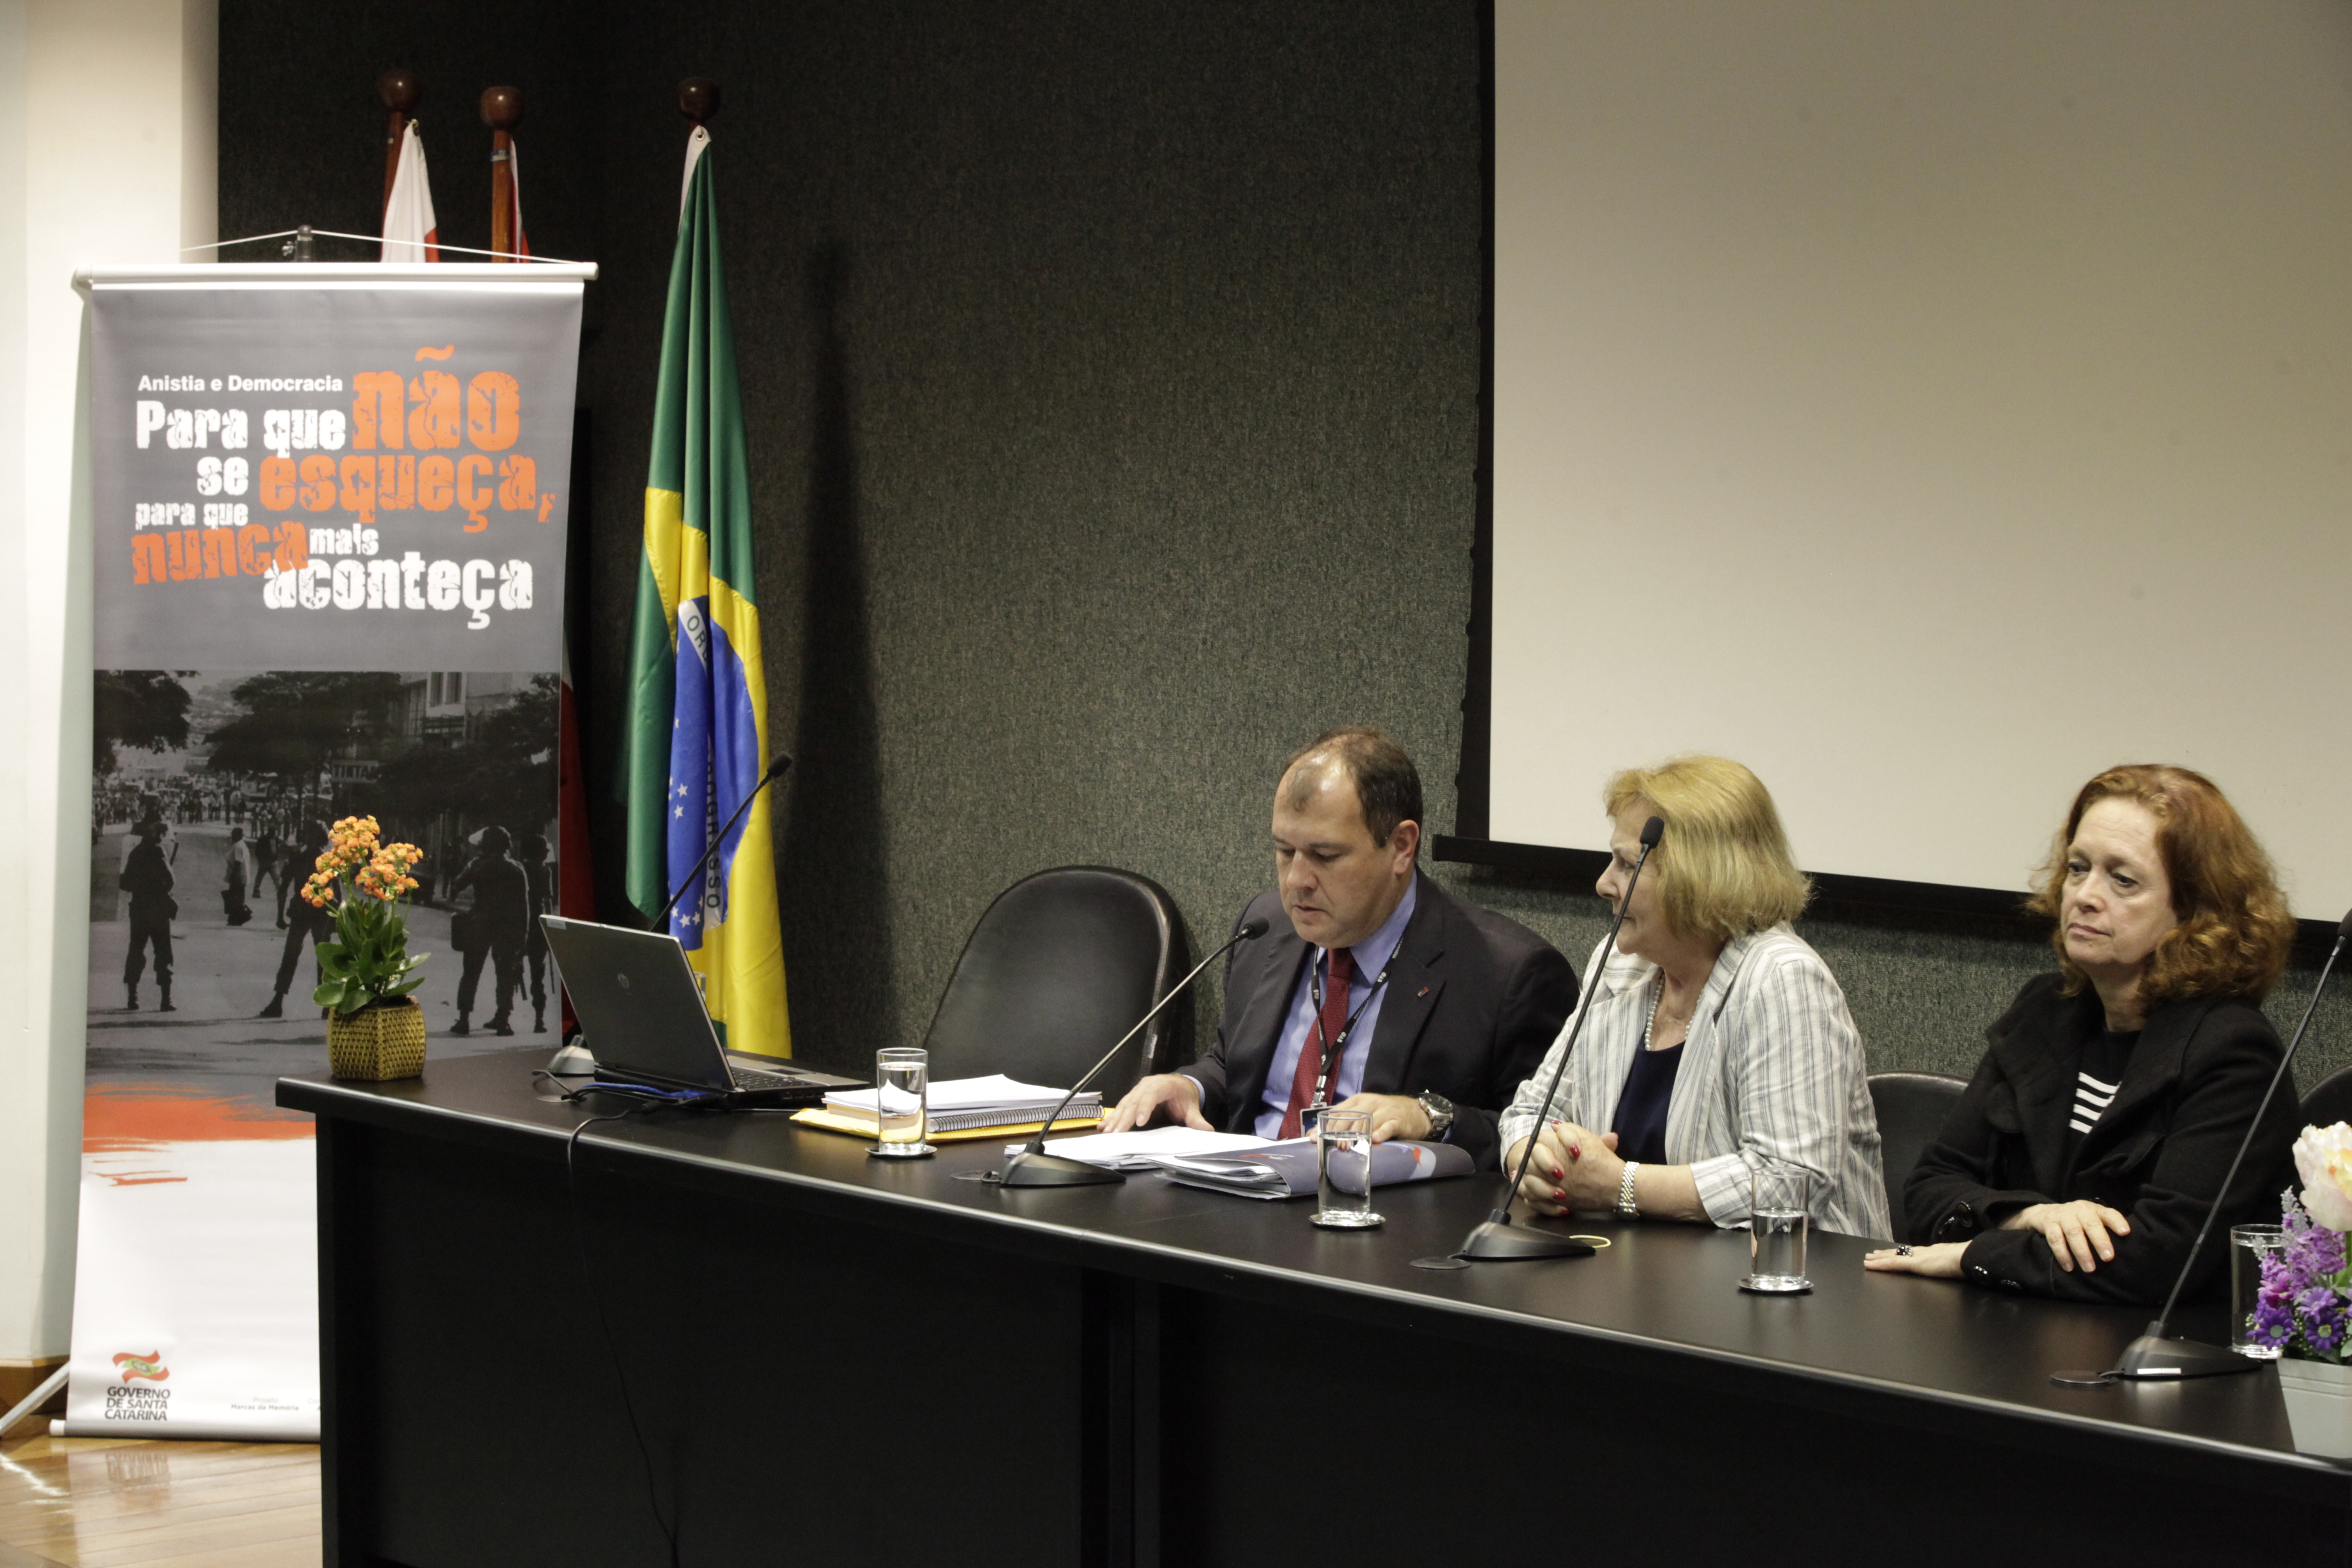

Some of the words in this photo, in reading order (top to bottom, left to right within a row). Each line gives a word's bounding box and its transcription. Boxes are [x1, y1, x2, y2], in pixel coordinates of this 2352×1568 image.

[138, 375, 205, 392] Anistia
[210, 378, 223, 392] e
[228, 375, 343, 392] Democracia
[136, 400, 248, 450] Para
[263, 409, 346, 459] que
[352, 345, 521, 451] não
[197, 456, 249, 496] se
[259, 454, 556, 533] esqueça,
[135, 503, 196, 530] para
[203, 503, 248, 530] que
[131, 521, 308, 585] nunca
[309, 523, 379, 555] mais
[263, 551, 533, 629] aconteça
[107, 1386, 170, 1399] GOVERNO
[107, 1398, 124, 1408] DE
[127, 1399, 168, 1409] SANTA
[105, 1409, 167, 1421] CATARINA
